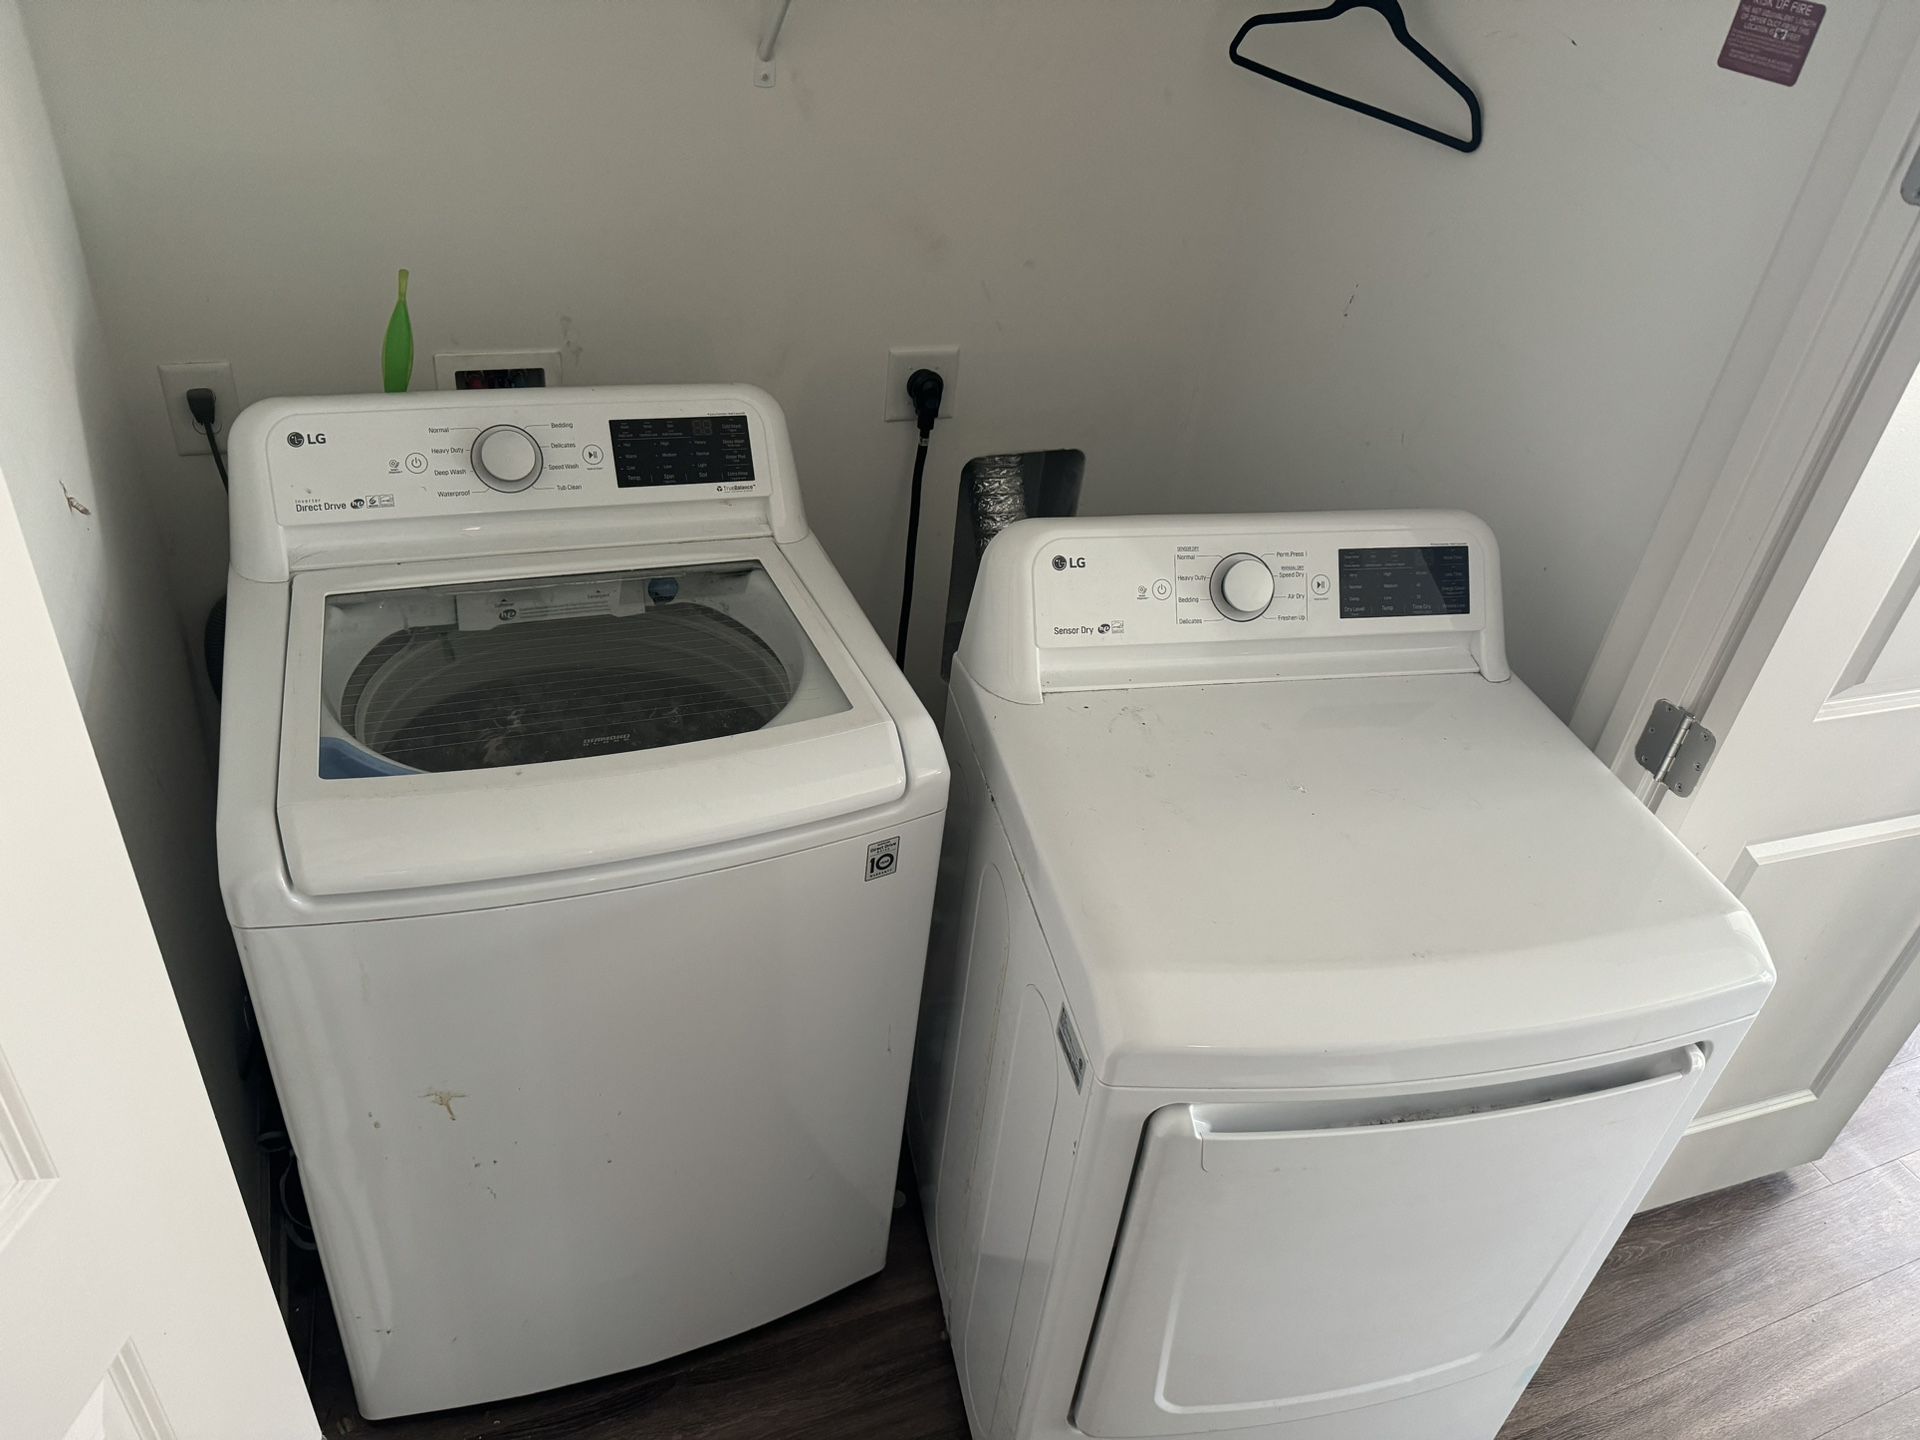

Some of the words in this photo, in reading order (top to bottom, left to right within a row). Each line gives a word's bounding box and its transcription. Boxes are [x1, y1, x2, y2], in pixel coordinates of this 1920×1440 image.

[1790, 1, 1814, 16] FIRE
[551, 421, 574, 429] Bedding
[307, 433, 326, 445] LG
[437, 490, 471, 498] Waterproof
[296, 503, 322, 512] Direct
[324, 502, 347, 510] Drive
[1069, 557, 1086, 568] LG
[1194, 574, 1207, 582] Duty
[1178, 596, 1199, 604] Bedding
[1179, 617, 1203, 625] Delicates
[1054, 626, 1079, 635] Sensor
[1080, 625, 1094, 635] Dry
[870, 853, 894, 873] 10
